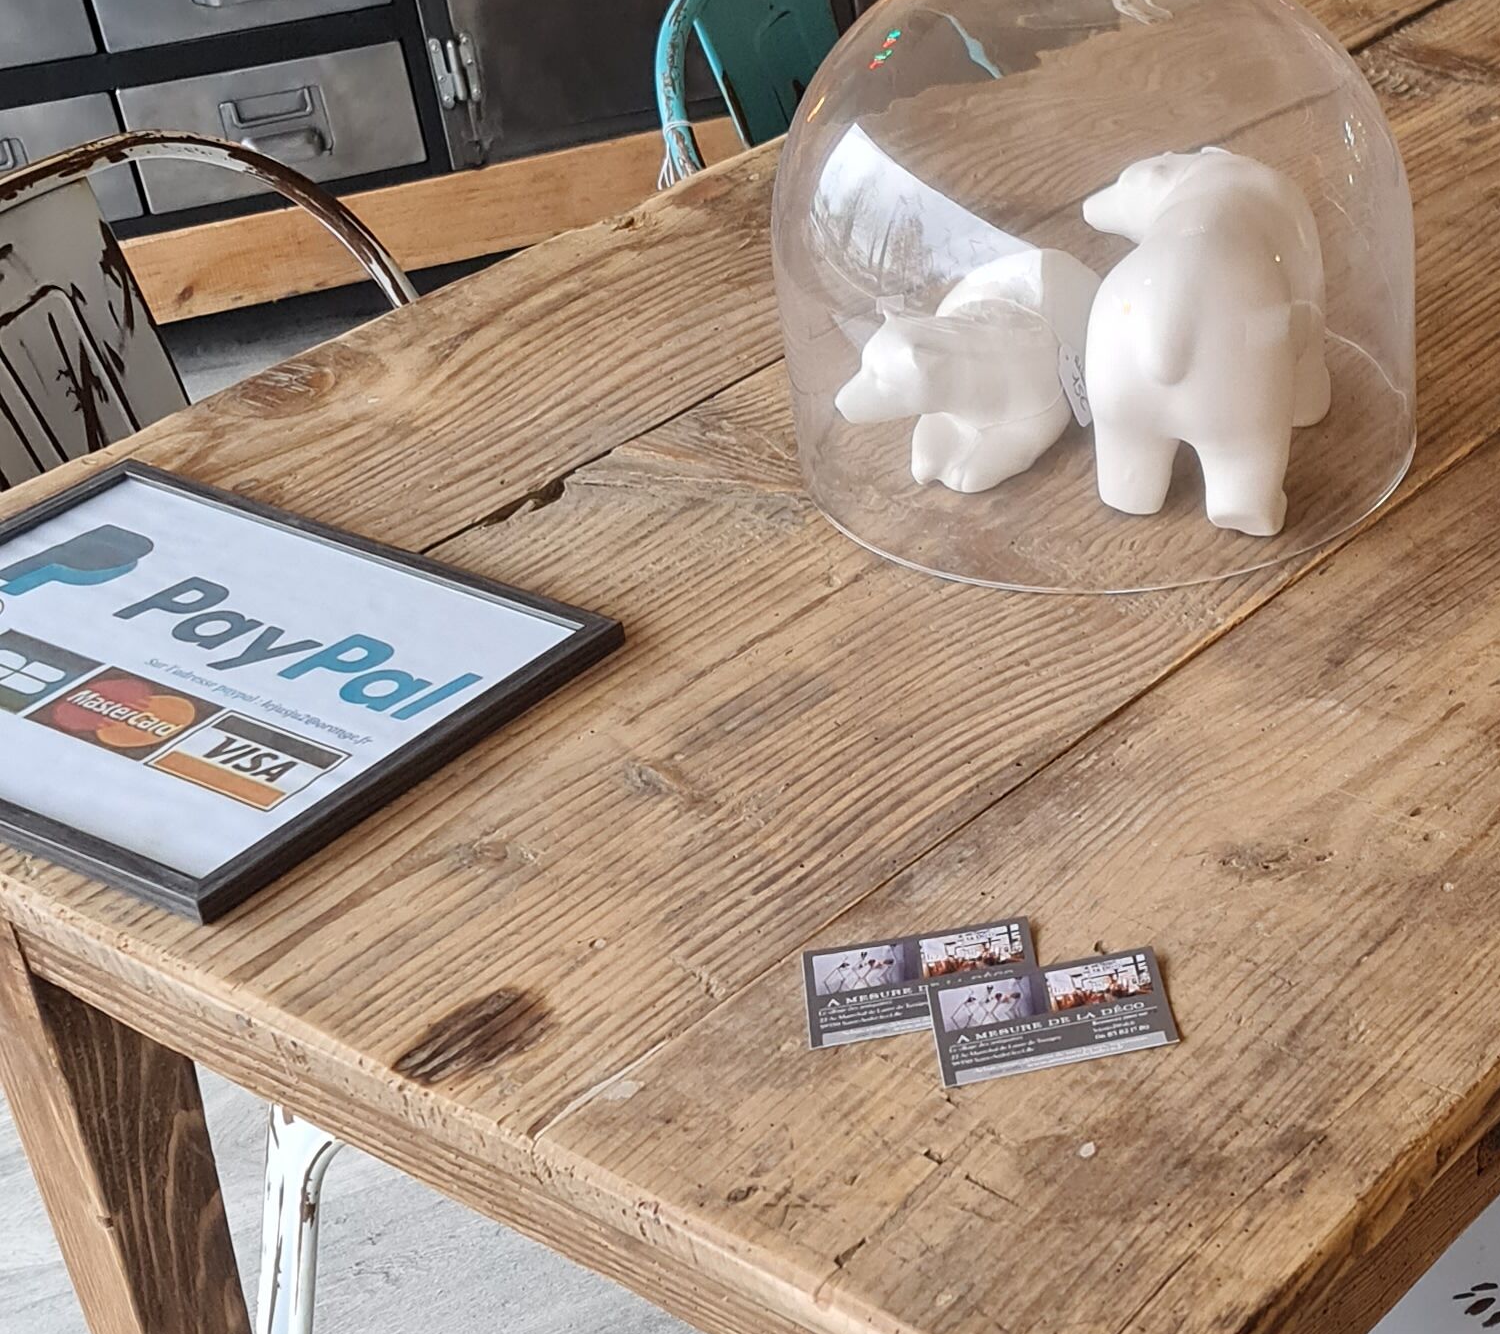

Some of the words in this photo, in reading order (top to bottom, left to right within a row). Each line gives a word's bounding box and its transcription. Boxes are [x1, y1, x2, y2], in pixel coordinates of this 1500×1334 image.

[113, 576, 484, 721] PayPal
[66, 689, 182, 737] MasterCard
[202, 735, 298, 784] VISA
[827, 998, 841, 1008] A
[956, 1034, 970, 1044] A
[975, 1022, 1043, 1040] MESURE
[1048, 1016, 1071, 1027] DE
[1076, 1012, 1096, 1022] LA
[1100, 1002, 1145, 1016] DÉCO
